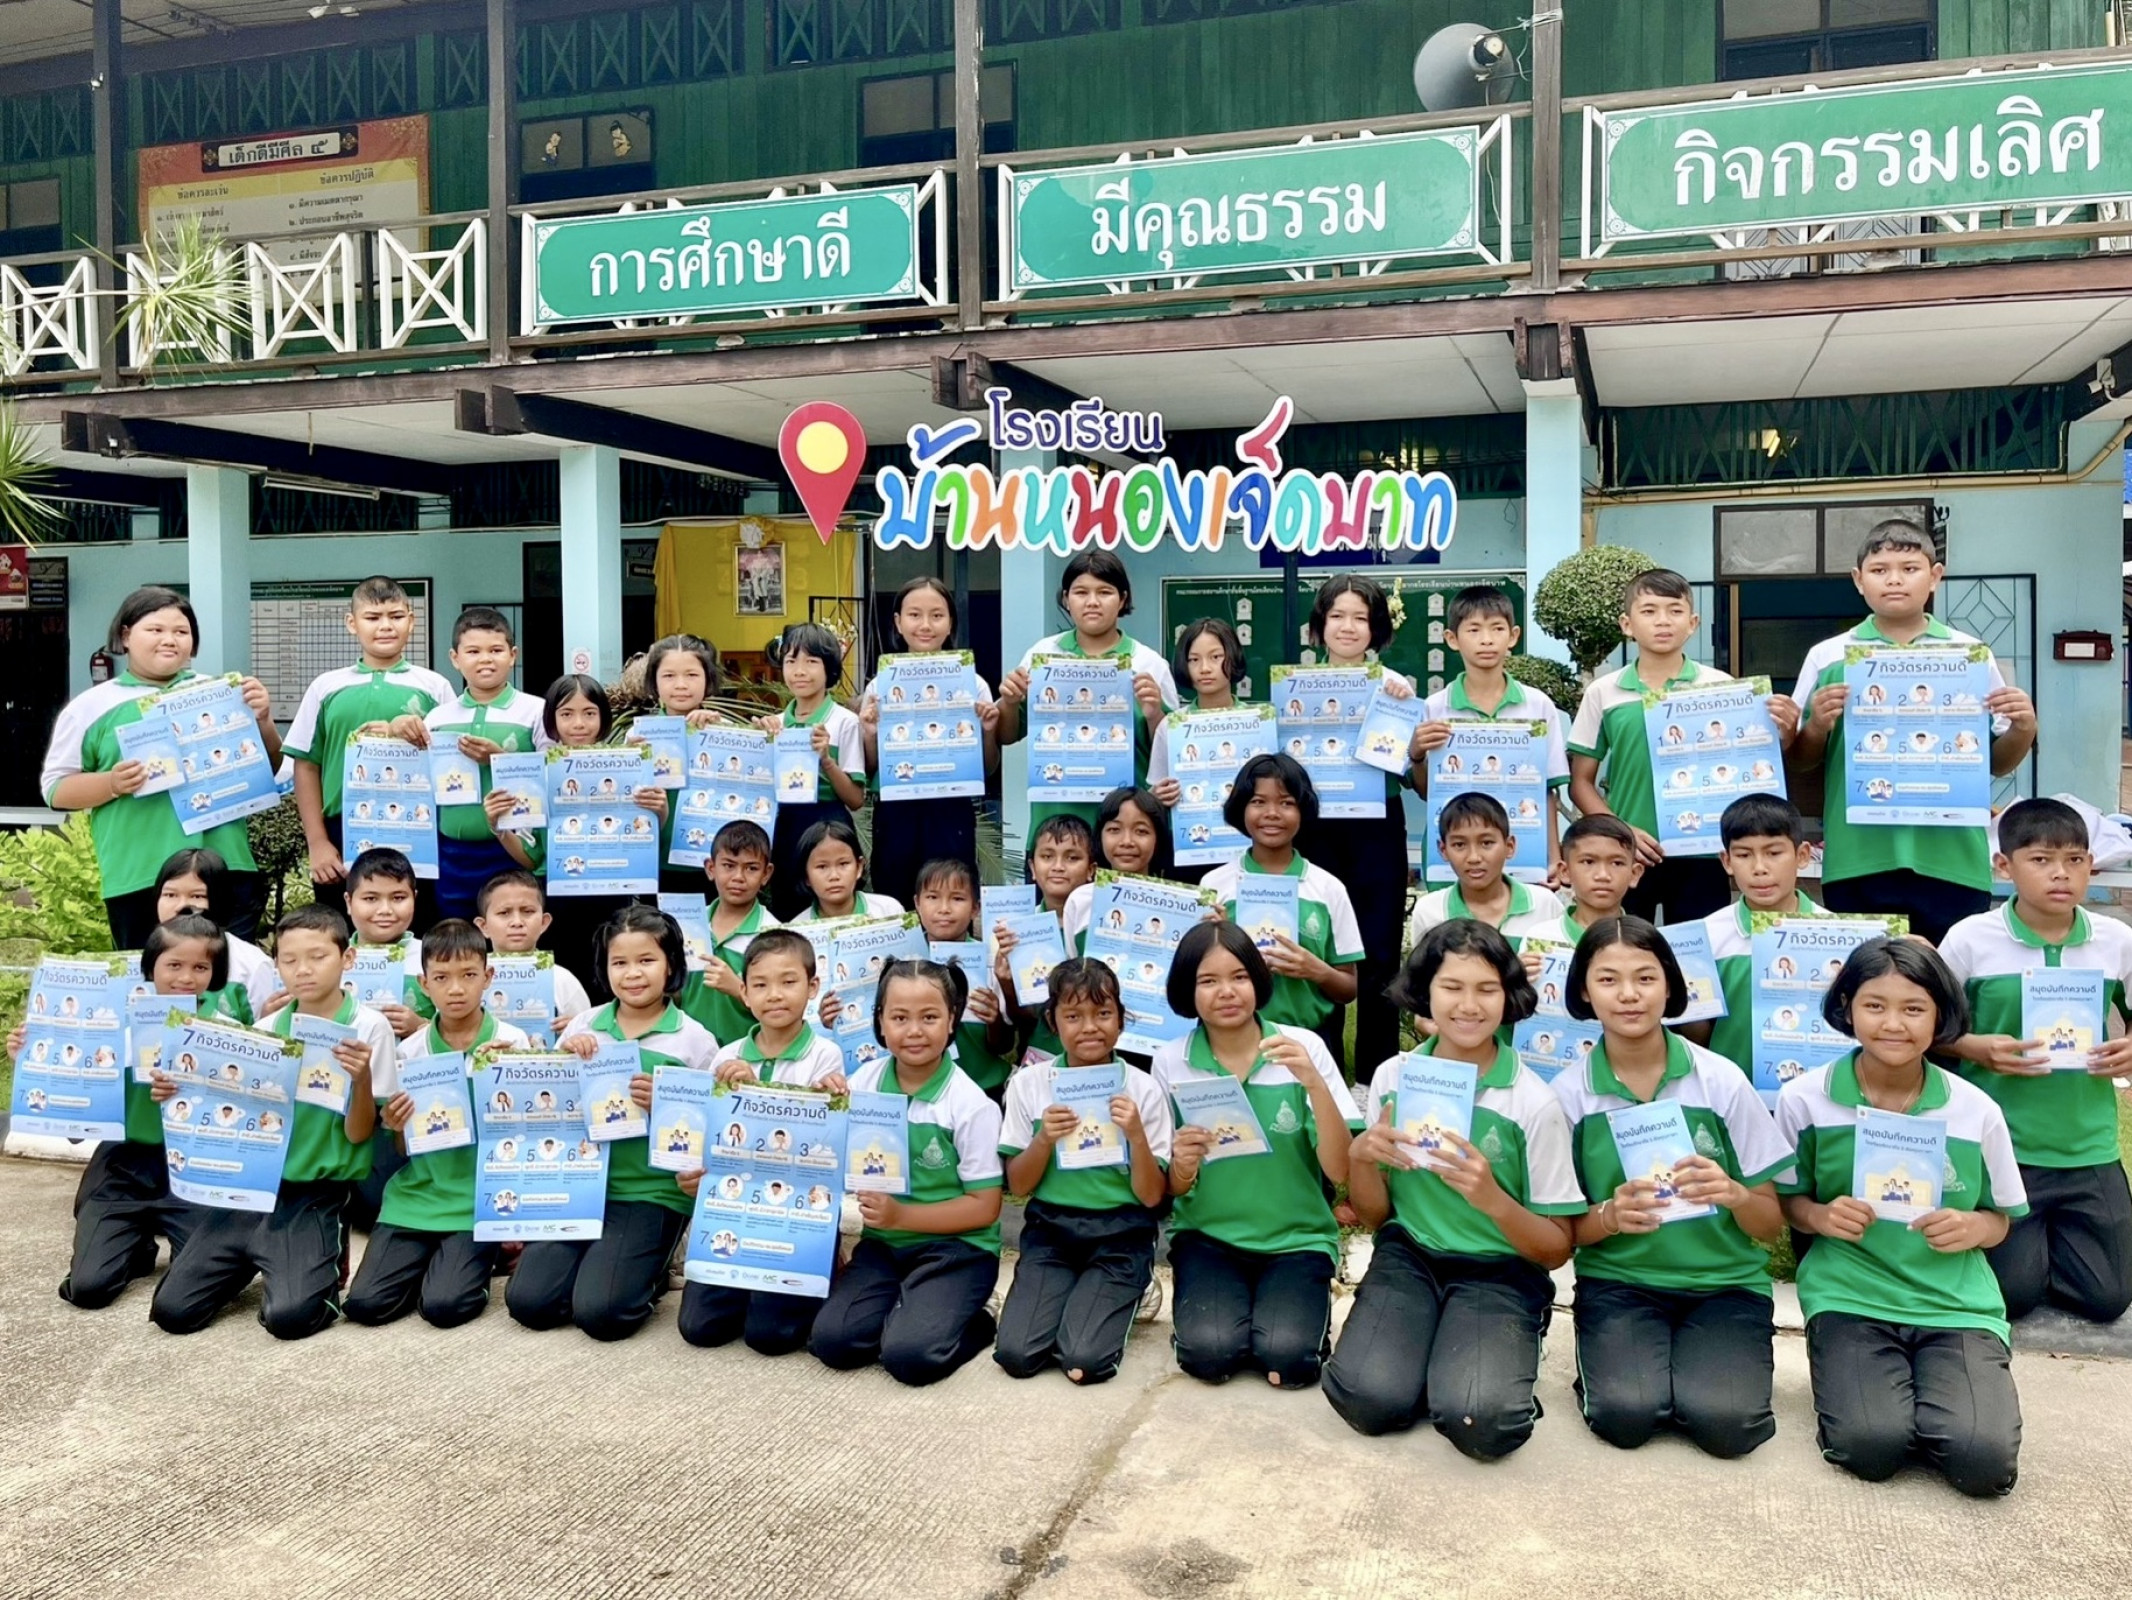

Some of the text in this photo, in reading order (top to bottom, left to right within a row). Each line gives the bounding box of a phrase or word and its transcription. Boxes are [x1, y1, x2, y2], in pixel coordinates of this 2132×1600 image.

[228, 139, 328, 164] เด็กดีมีศีล ๕
[1673, 95, 2104, 205] กิจกรรมเลิศ
[1090, 177, 1387, 271] มีคุณธรรม
[589, 206, 851, 297] การศึกษาดี
[989, 391, 1163, 449] โรงเรียน
[877, 397, 1455, 554] บ้านหนองเจ็ดบาท
[889, 667, 897, 681] 7
[1044, 667, 1051, 681] 7
[1865, 661, 1876, 678] 7
[1288, 679, 1297, 693] 7
[1855, 695, 1860, 706] 1
[1899, 695, 1907, 706] 2
[1943, 694, 1951, 706] 3
[1662, 703, 1672, 718] 7
[1183, 724, 1191, 738] 7
[700, 733, 707, 746] 7
[1448, 733, 1456, 748] 7
[356, 746, 363, 758] 7
[1854, 743, 1863, 752] 4
[1899, 742, 1907, 752] 5
[1943, 742, 1951, 753] 6
[564, 760, 573, 774] 7
[1856, 781, 1864, 792] 7
[1111, 887, 1122, 902] 7
[1100, 917, 1104, 926] 1
[1134, 924, 1142, 934] 2
[1172, 929, 1180, 940] 3
[1774, 932, 1870, 949] 7 กิจวัตรควา
[1545, 957, 1556, 974] 7
[1127, 969, 1135, 980] 5
[1764, 968, 1770, 979] 1
[1810, 968, 1820, 981] 2
[1811, 1019, 1820, 1032] 5
[182, 1029, 194, 1045] 7
[168, 1059, 173, 1070] 1
[1764, 1061, 1773, 1074] 7
[209, 1068, 218, 1079] 2
[492, 1066, 578, 1084] 7 กิจวัตรความ
[251, 1078, 260, 1089] 3
[486, 1103, 490, 1112] 1
[525, 1101, 533, 1112] 2
[566, 1100, 574, 1111] 3
[731, 1096, 742, 1114] 7
[743, 1098, 826, 1119] กิจวัตรความดี
[201, 1113, 210, 1125] 5
[246, 1118, 255, 1130] 6
[716, 1133, 720, 1145] 1
[756, 1139, 765, 1152] 2
[486, 1151, 494, 1161] 4
[527, 1149, 535, 1161] 5
[567, 1149, 575, 1161] 6
[800, 1144, 809, 1157] 3
[707, 1185, 716, 1197] 4
[752, 1191, 760, 1204] 5
[484, 1193, 492, 1206] 7
[795, 1196, 803, 1209] 6
[701, 1232, 710, 1244] 7
